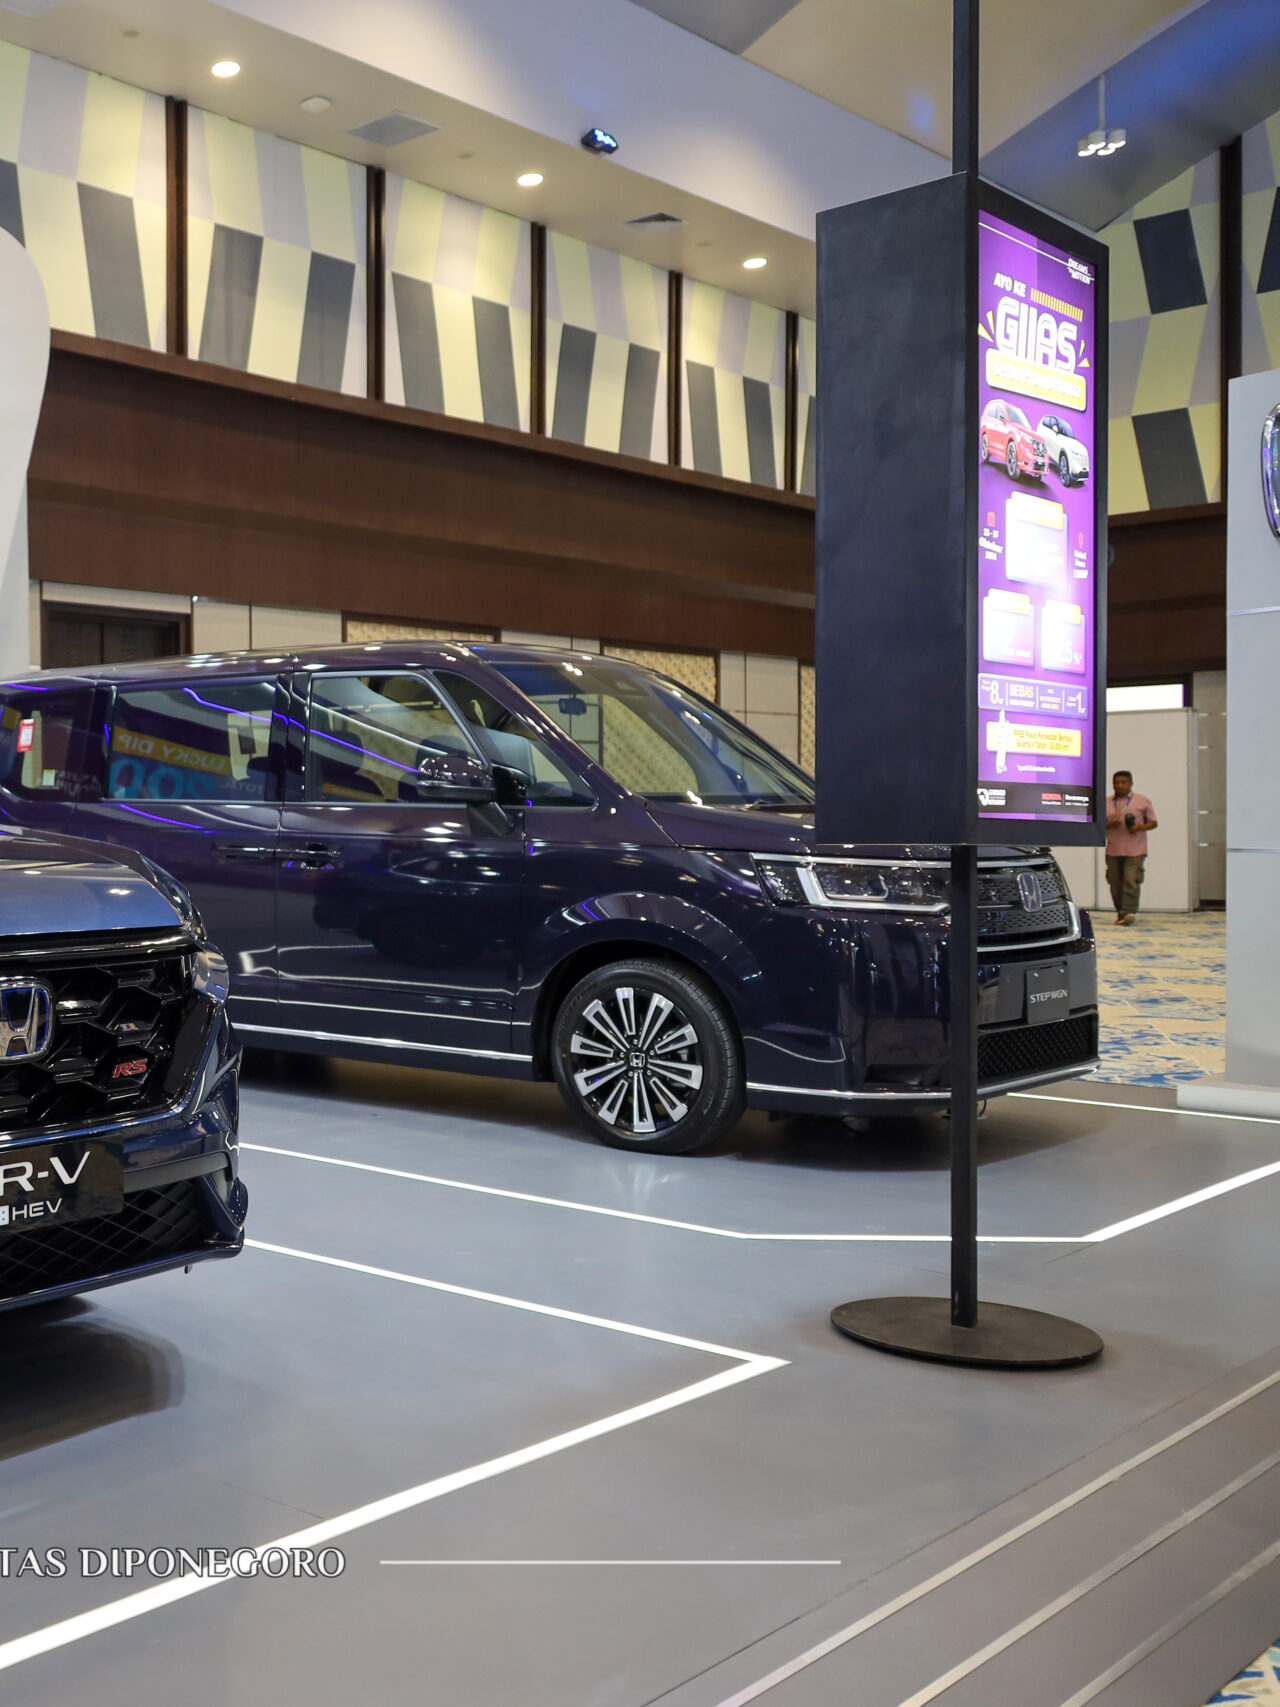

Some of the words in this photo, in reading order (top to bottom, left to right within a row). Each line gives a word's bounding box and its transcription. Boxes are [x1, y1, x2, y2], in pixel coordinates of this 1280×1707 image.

[993, 272, 1012, 291] AYO
[1013, 279, 1027, 298] KE
[996, 296, 1079, 374] GIIAS
[112, 1058, 148, 1078] RS
